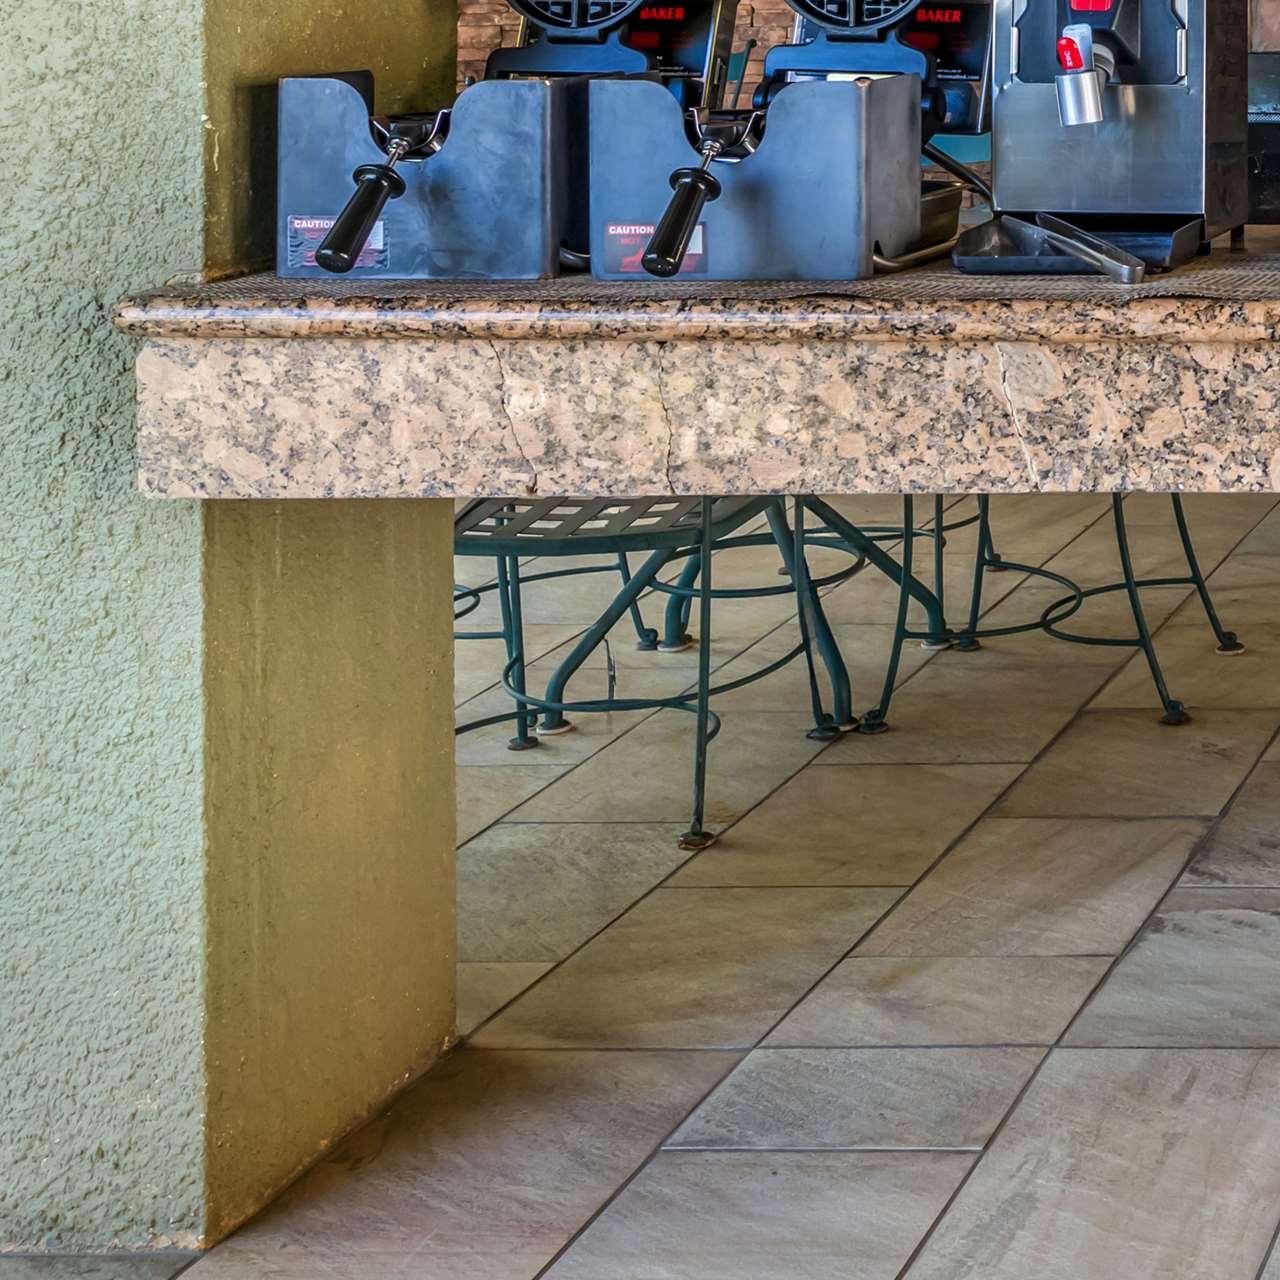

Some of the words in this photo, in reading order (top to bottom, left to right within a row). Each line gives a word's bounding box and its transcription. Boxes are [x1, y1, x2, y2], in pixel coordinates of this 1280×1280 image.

[640, 6, 685, 20] BAKER
[916, 8, 962, 23] BAKER
[608, 226, 655, 234] CAUTION
